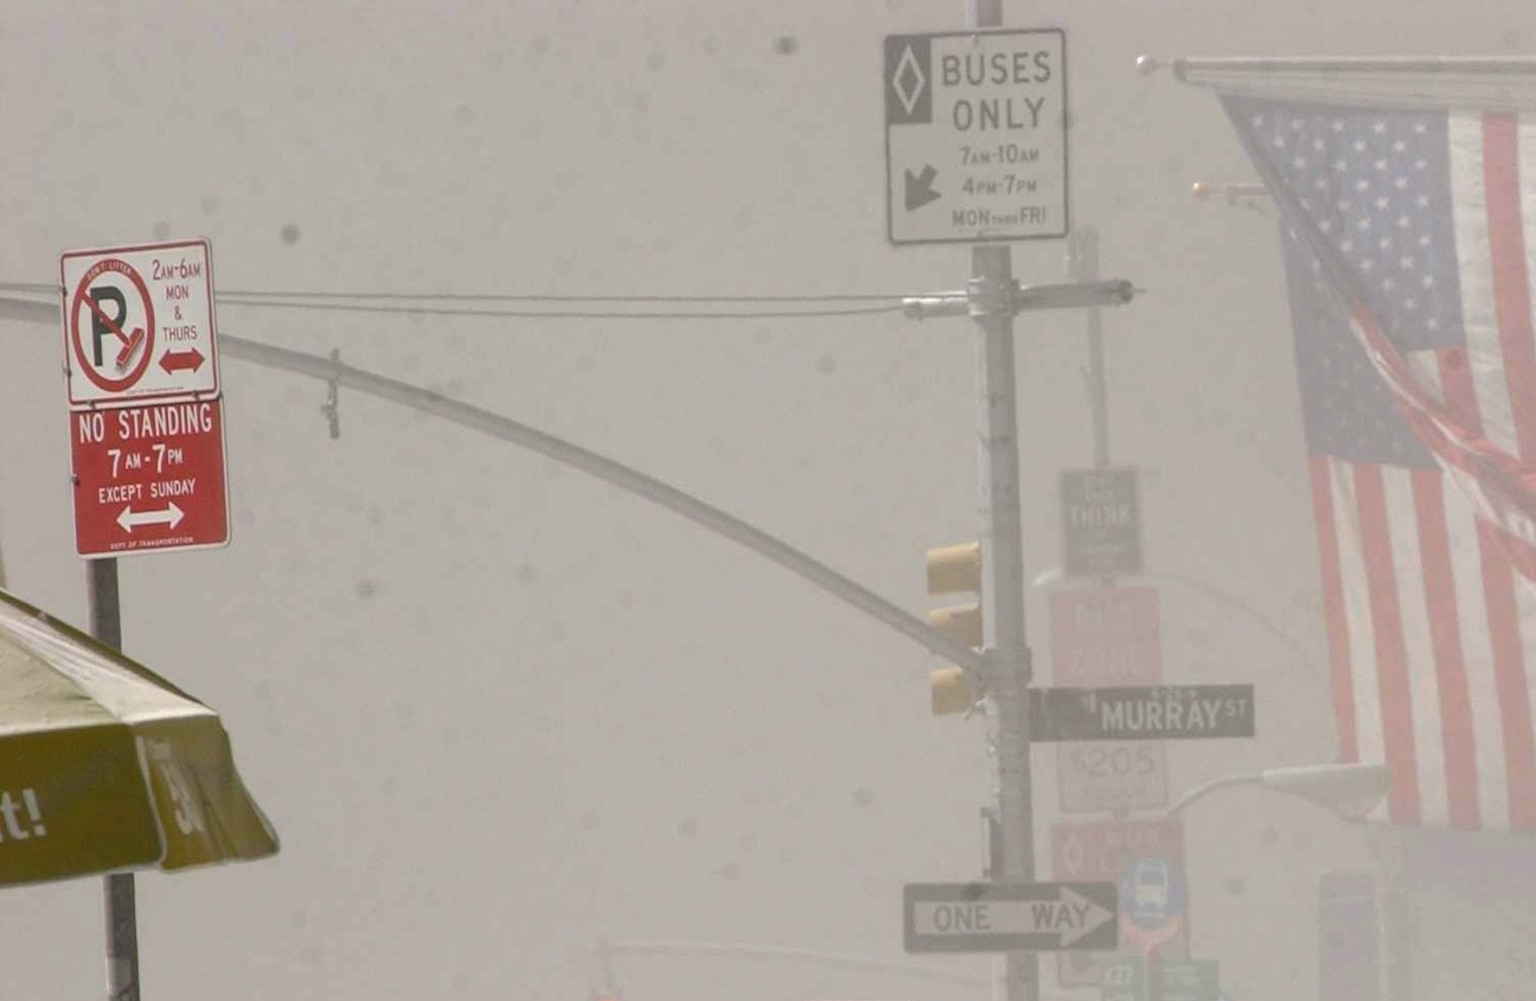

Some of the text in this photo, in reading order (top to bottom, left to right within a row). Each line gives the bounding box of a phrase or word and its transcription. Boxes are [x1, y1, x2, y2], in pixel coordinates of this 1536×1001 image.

[942, 51, 1051, 86] BUSES
[953, 97, 1045, 131] ONLY
[165, 287, 189, 300] MON
[174, 306, 182, 320] &
[163, 325, 197, 341] THURS
[79, 404, 212, 443] NO STANDING
[99, 478, 196, 503] EXCEPT SUNDAY
[1069, 504, 1132, 527] THINK
[1102, 699, 1248, 732] MURRAY ST
[0, 787, 46, 842] t!
[934, 903, 1090, 932] ONE WAY
